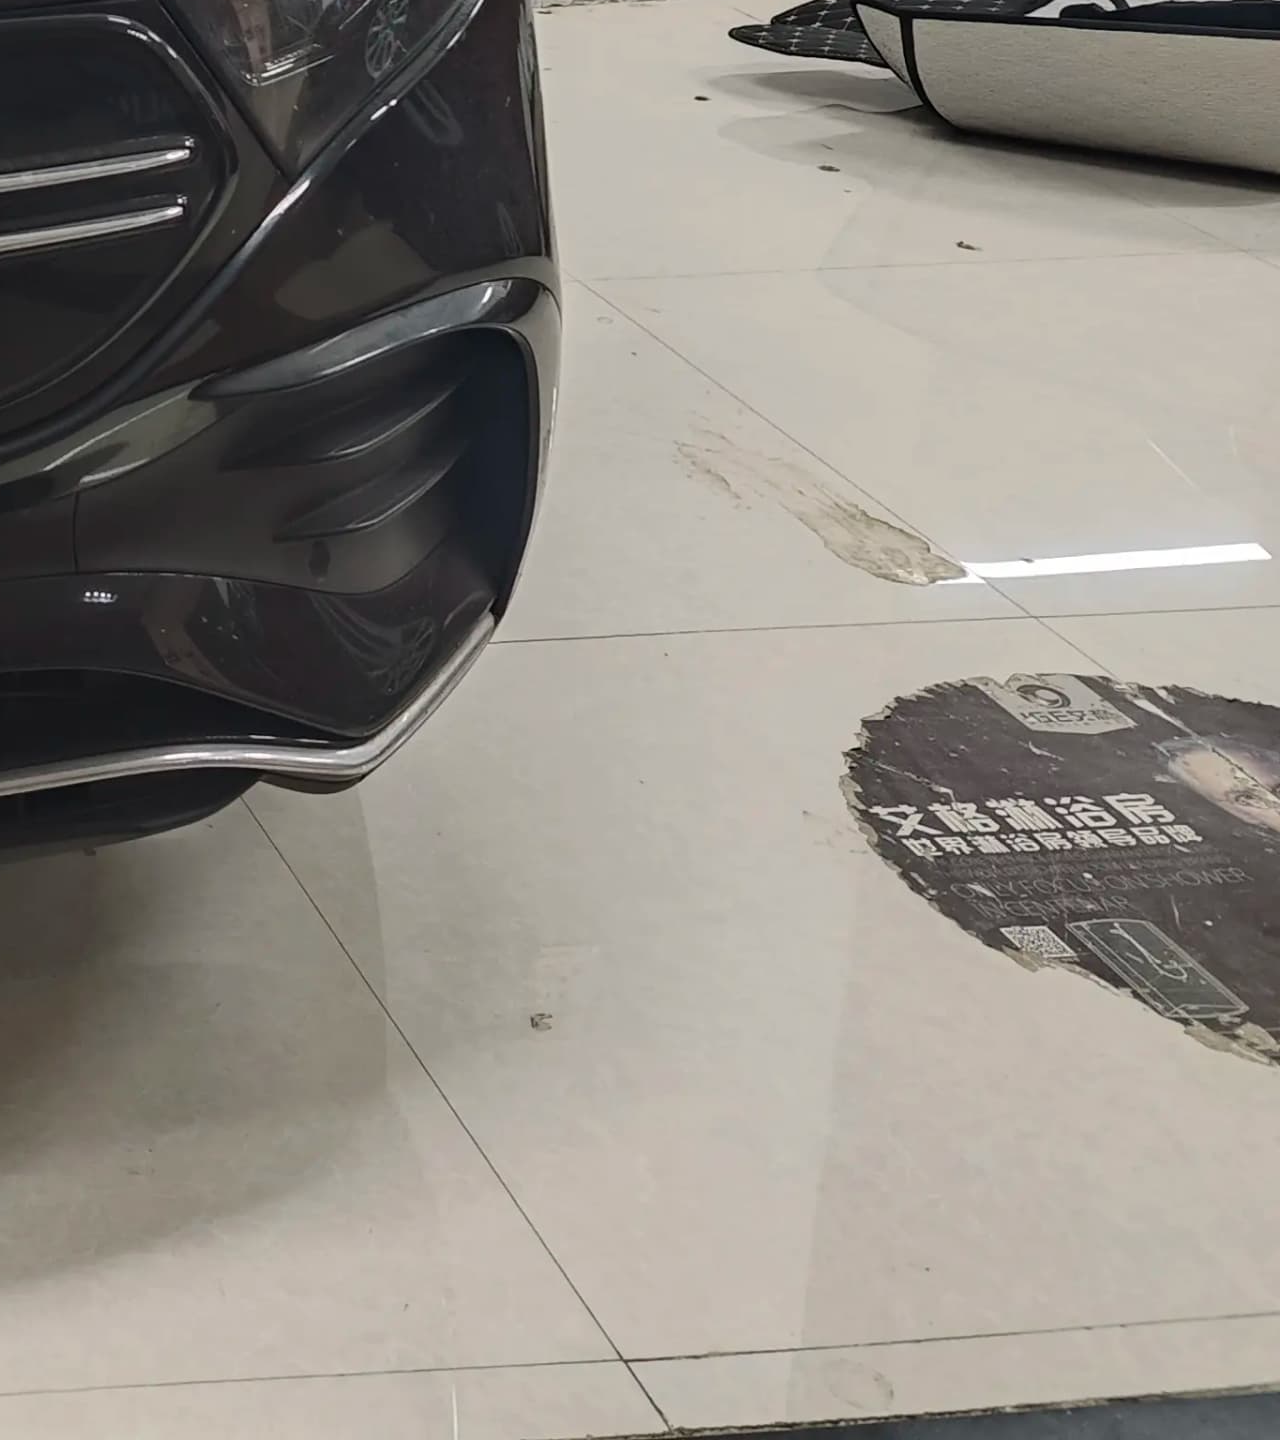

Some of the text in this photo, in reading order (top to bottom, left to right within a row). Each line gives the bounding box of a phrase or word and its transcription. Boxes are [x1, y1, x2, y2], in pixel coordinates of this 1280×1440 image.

[868, 792, 1175, 836] 艾格淋浴房
[901, 824, 1203, 856] 世界淋浴房领导品牌
[1144, 867, 1254, 888] SHOWER
